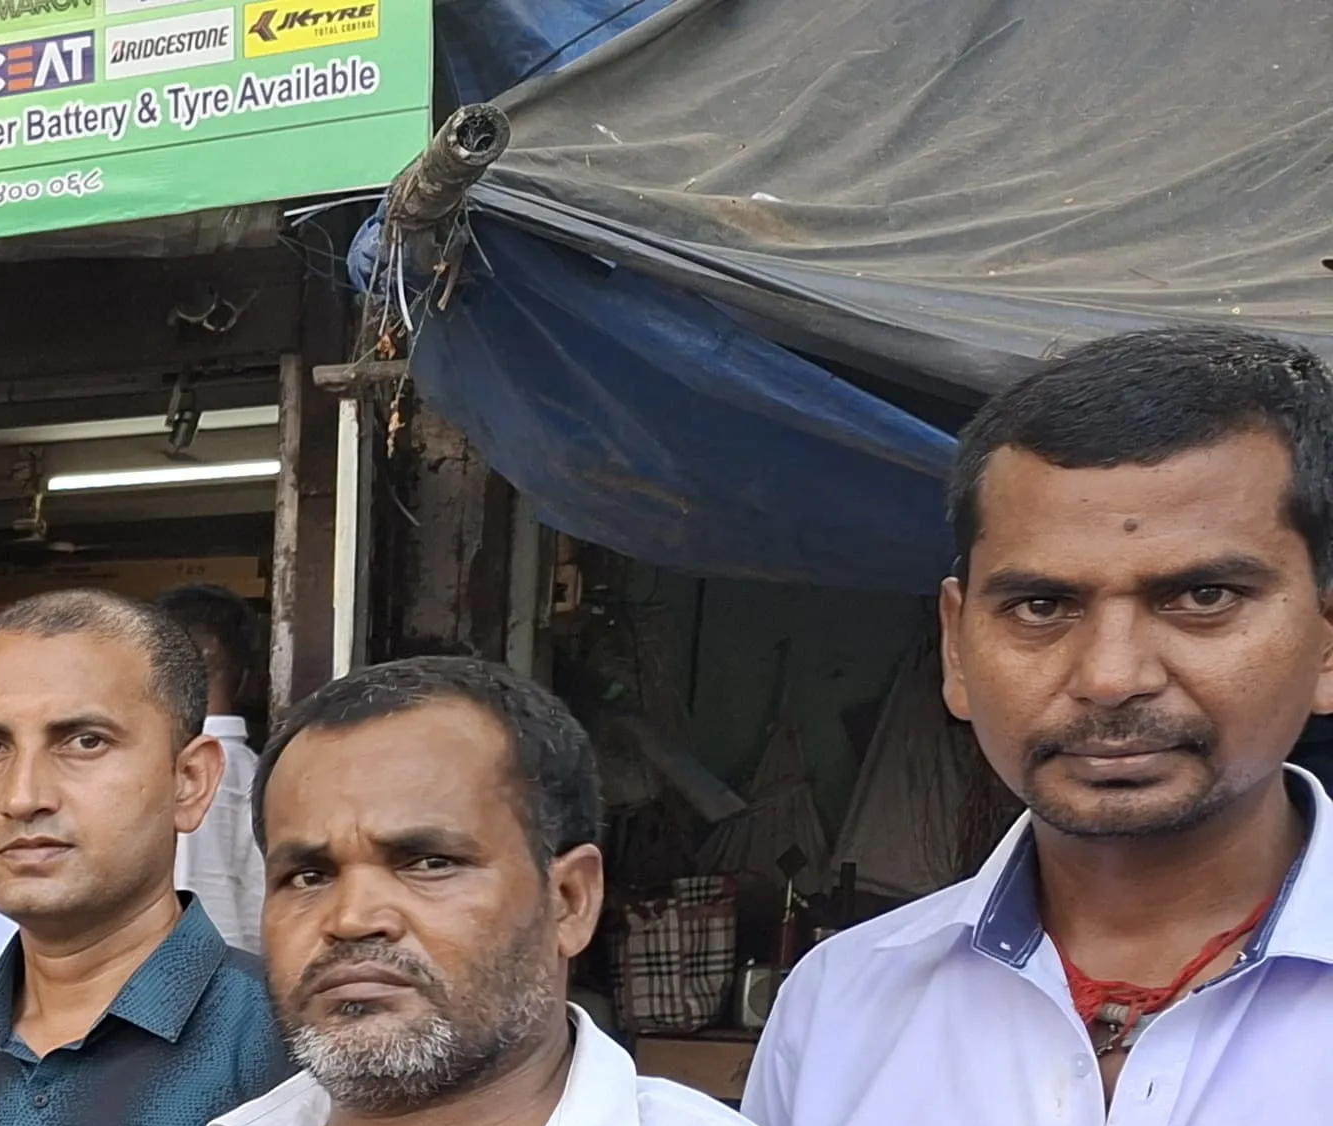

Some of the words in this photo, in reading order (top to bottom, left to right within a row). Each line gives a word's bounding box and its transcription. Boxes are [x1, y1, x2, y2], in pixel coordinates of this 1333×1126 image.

[110, 26, 230, 64] BRIDGESTONE
[26, 102, 128, 140] Battery
[137, 92, 158, 123] &
[168, 84, 230, 125] Tyre
[237, 60, 377, 108] Available
